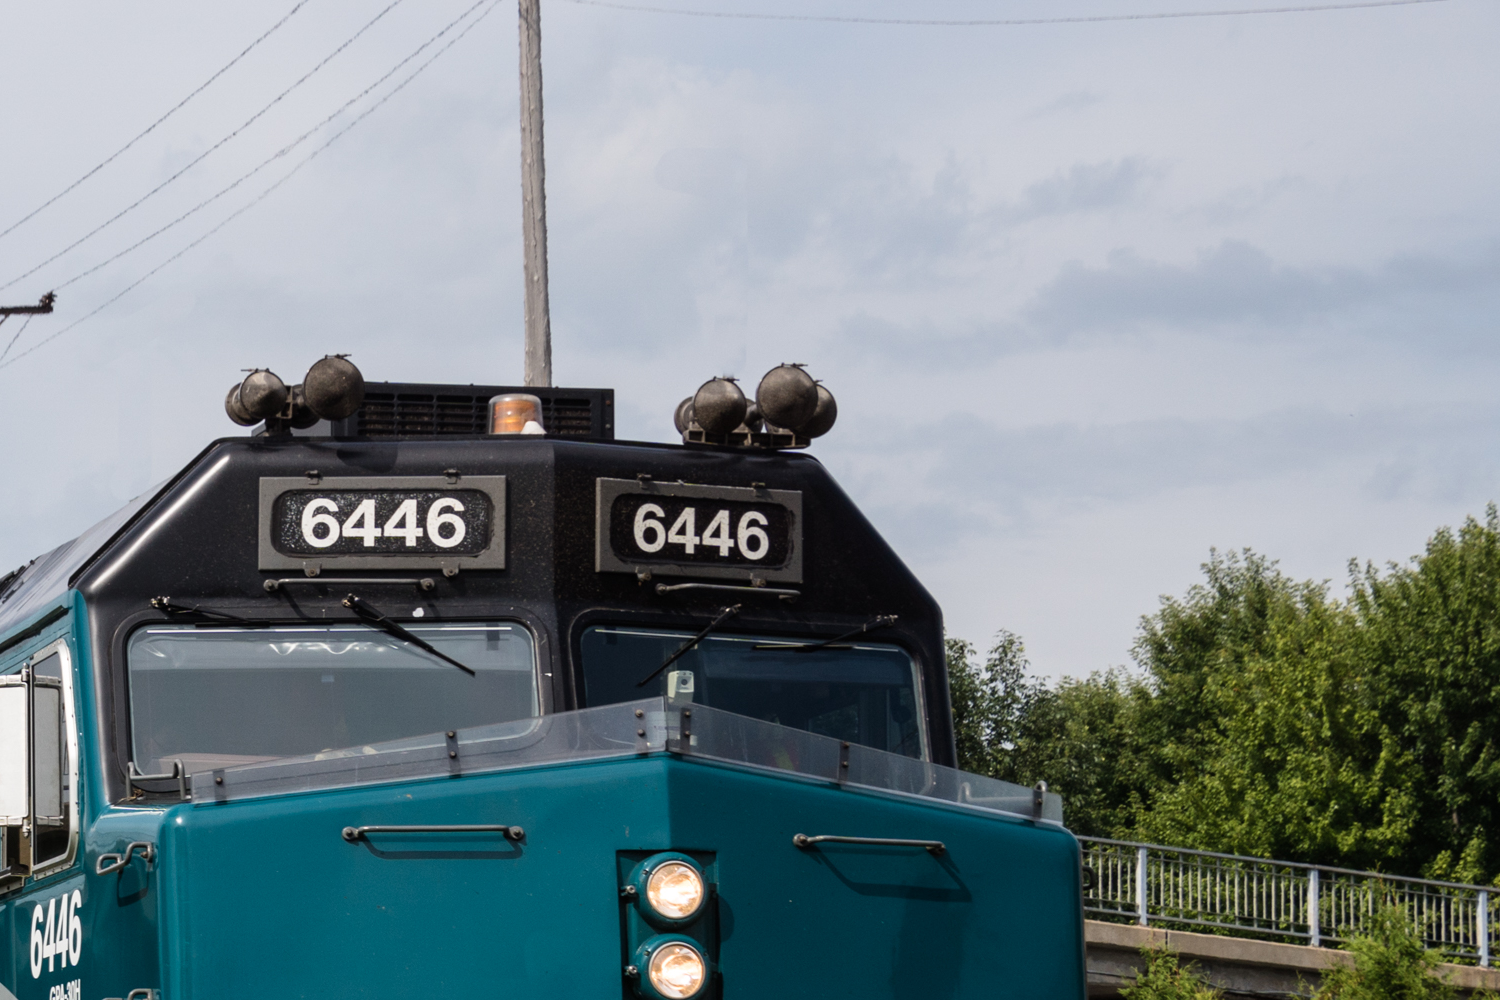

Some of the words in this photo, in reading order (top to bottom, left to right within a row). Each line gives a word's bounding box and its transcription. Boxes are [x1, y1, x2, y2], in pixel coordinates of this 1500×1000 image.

[300, 496, 466, 549] 6446
[632, 502, 770, 561] 6446
[30, 889, 82, 979] 6446
